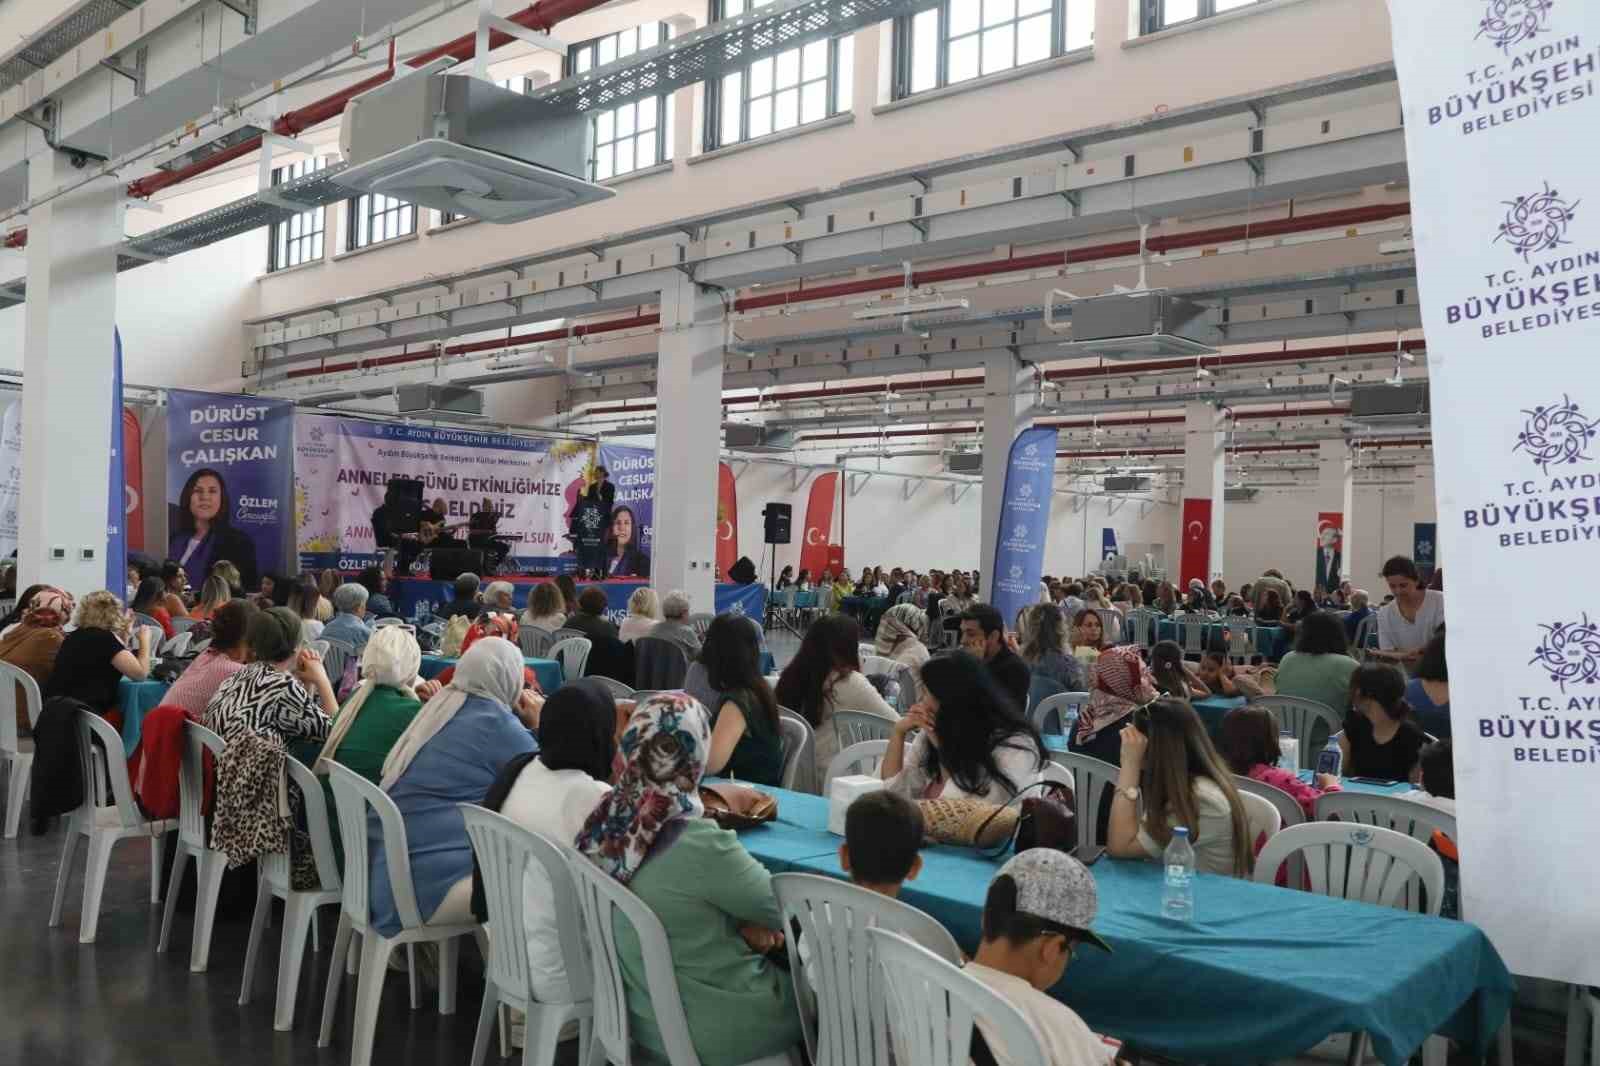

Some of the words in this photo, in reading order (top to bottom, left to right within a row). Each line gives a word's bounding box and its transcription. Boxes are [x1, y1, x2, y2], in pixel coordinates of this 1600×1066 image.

[1466, 64, 1504, 86] T.C.
[1511, 35, 1580, 71] AYDIN
[1428, 46, 1600, 126] BÜYÜKŞEH
[1462, 80, 1593, 135] BELEDİYESİ
[1484, 270, 1523, 288] T.C.
[1531, 251, 1600, 279] AYDIN
[190, 404, 269, 424] DÜRÜST
[200, 427, 258, 443] CESUR
[181, 445, 278, 467] ÇALIŞKAN
[462, 475, 561, 496] ETKİNLİĞİMİZE
[1504, 481, 1542, 496] T.C.
[240, 495, 278, 509] ÖZLEM
[1500, 525, 1600, 547] BELEDİY
[1519, 697, 1559, 711] T.C.
[1567, 696, 1600, 711] AY
[1514, 746, 1600, 763] BELEDİ
